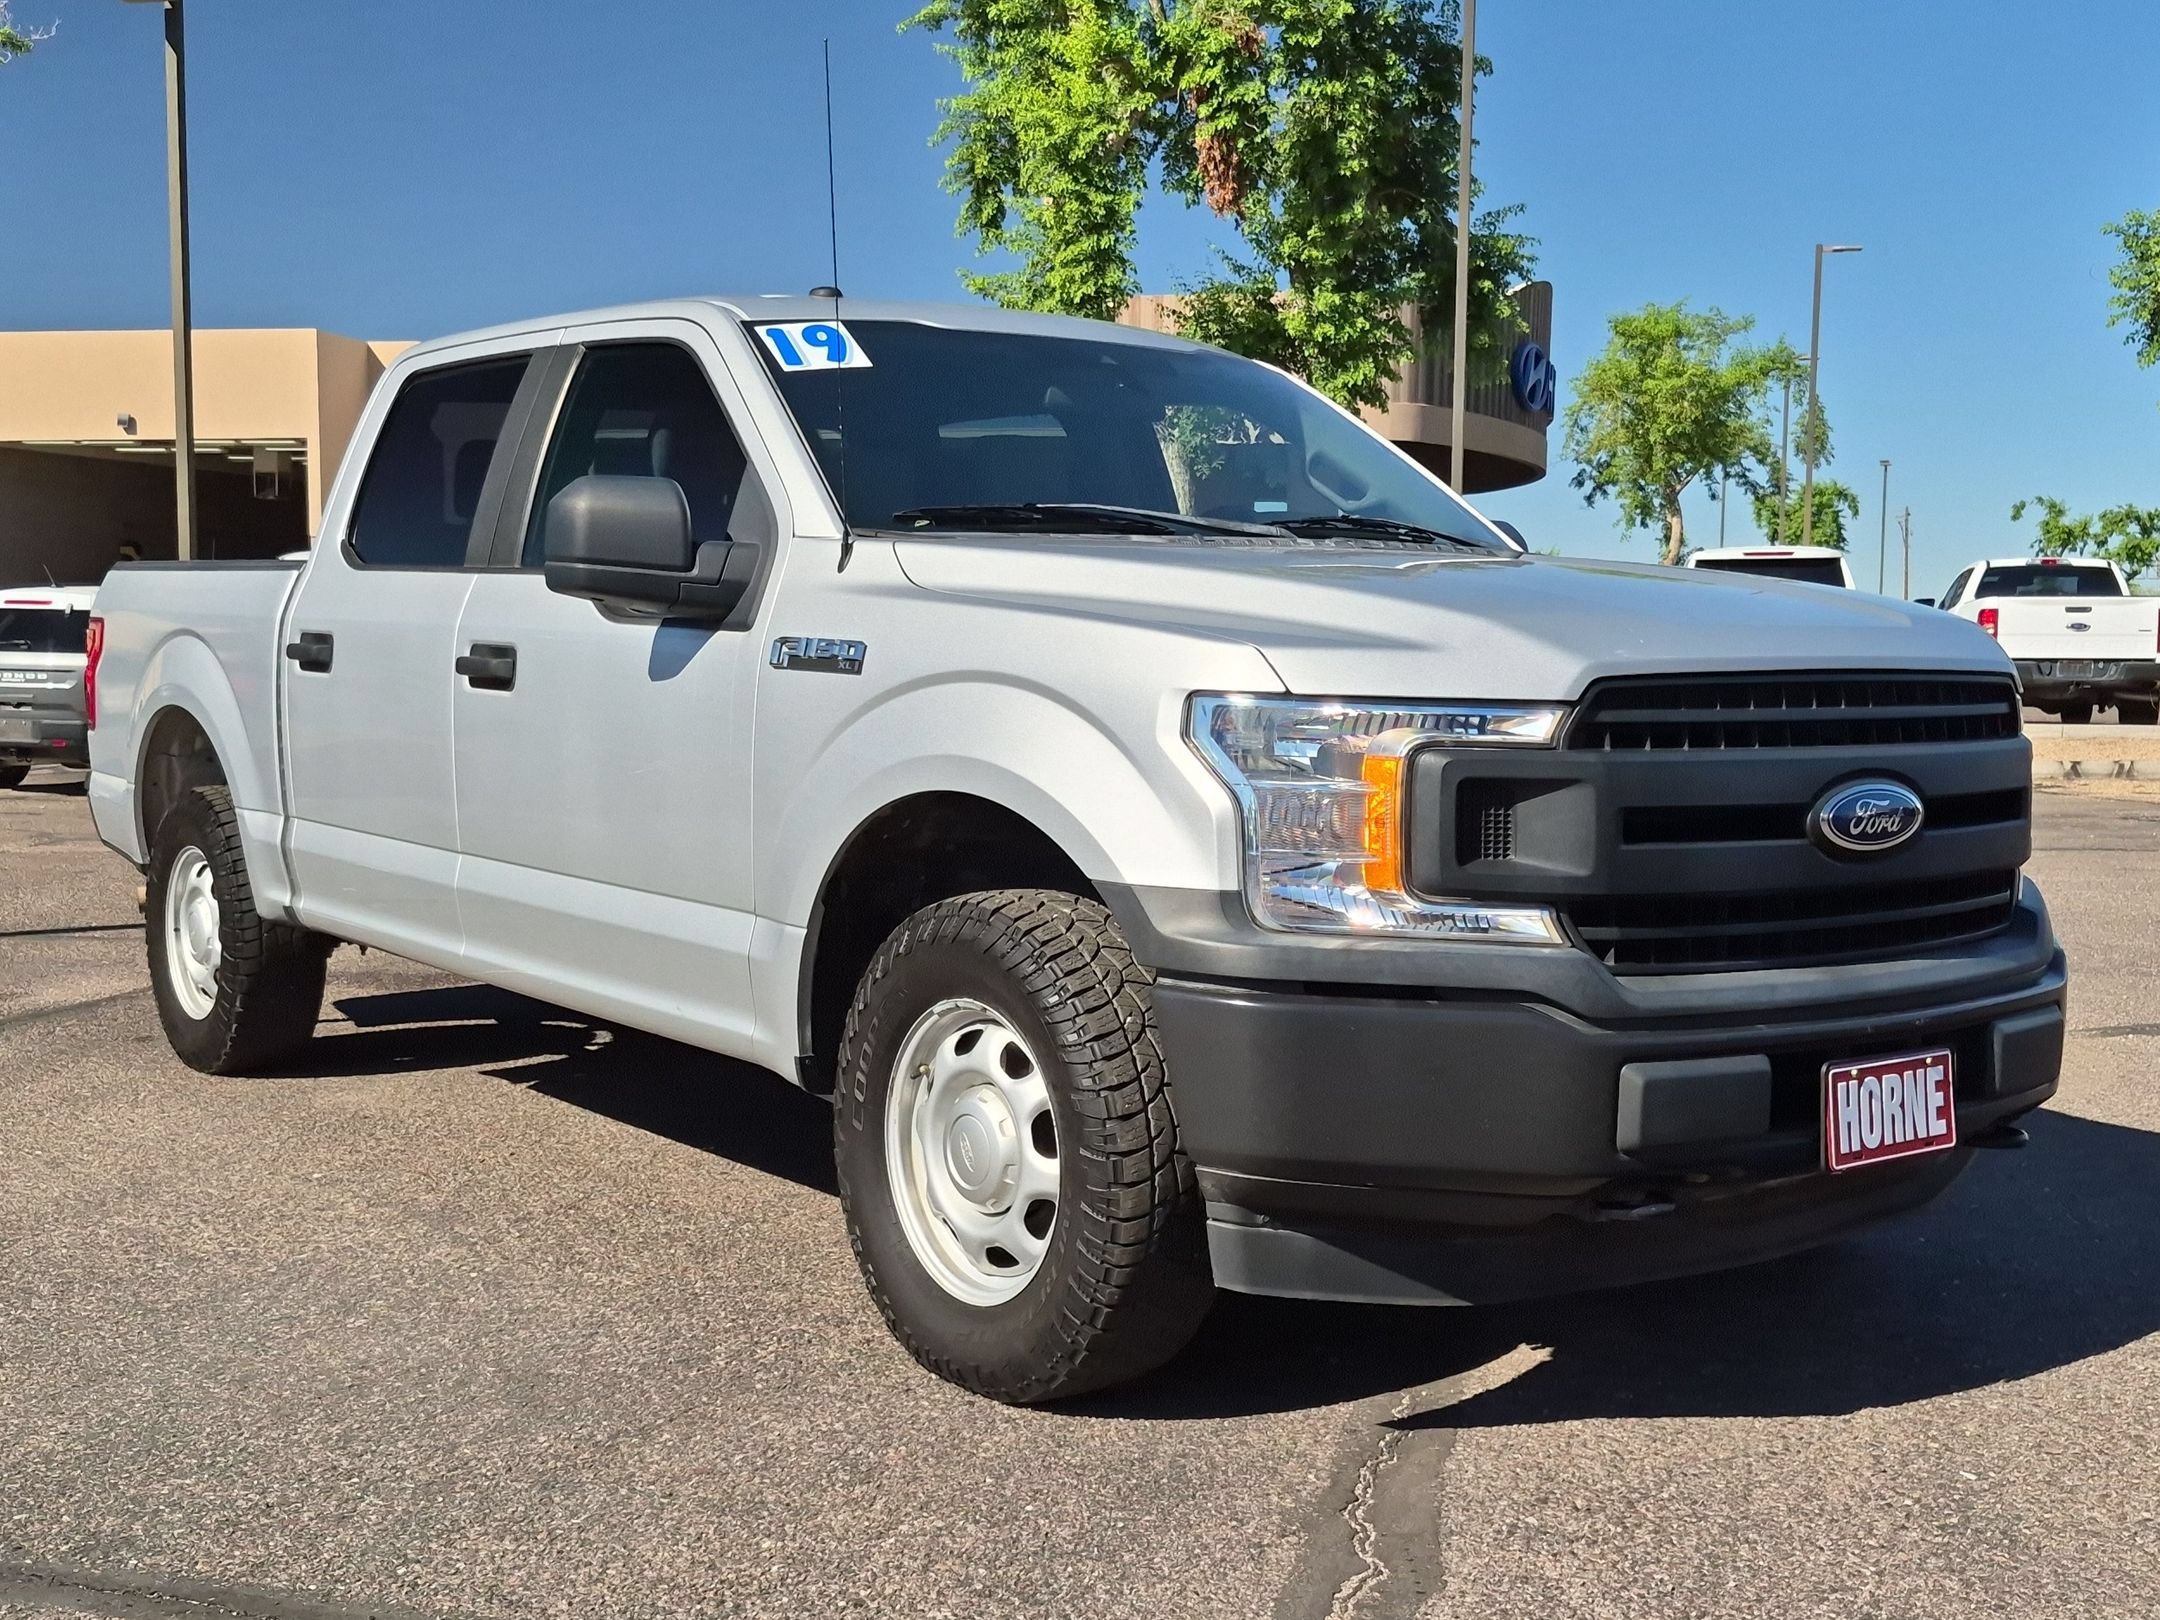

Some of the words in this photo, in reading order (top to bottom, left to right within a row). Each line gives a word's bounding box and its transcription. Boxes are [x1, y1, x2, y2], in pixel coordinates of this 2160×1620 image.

[765, 324, 848, 366] 19
[837, 660, 853, 670] XL
[1849, 799, 1905, 835] Ford
[1837, 1065, 1948, 1155] HORNE
